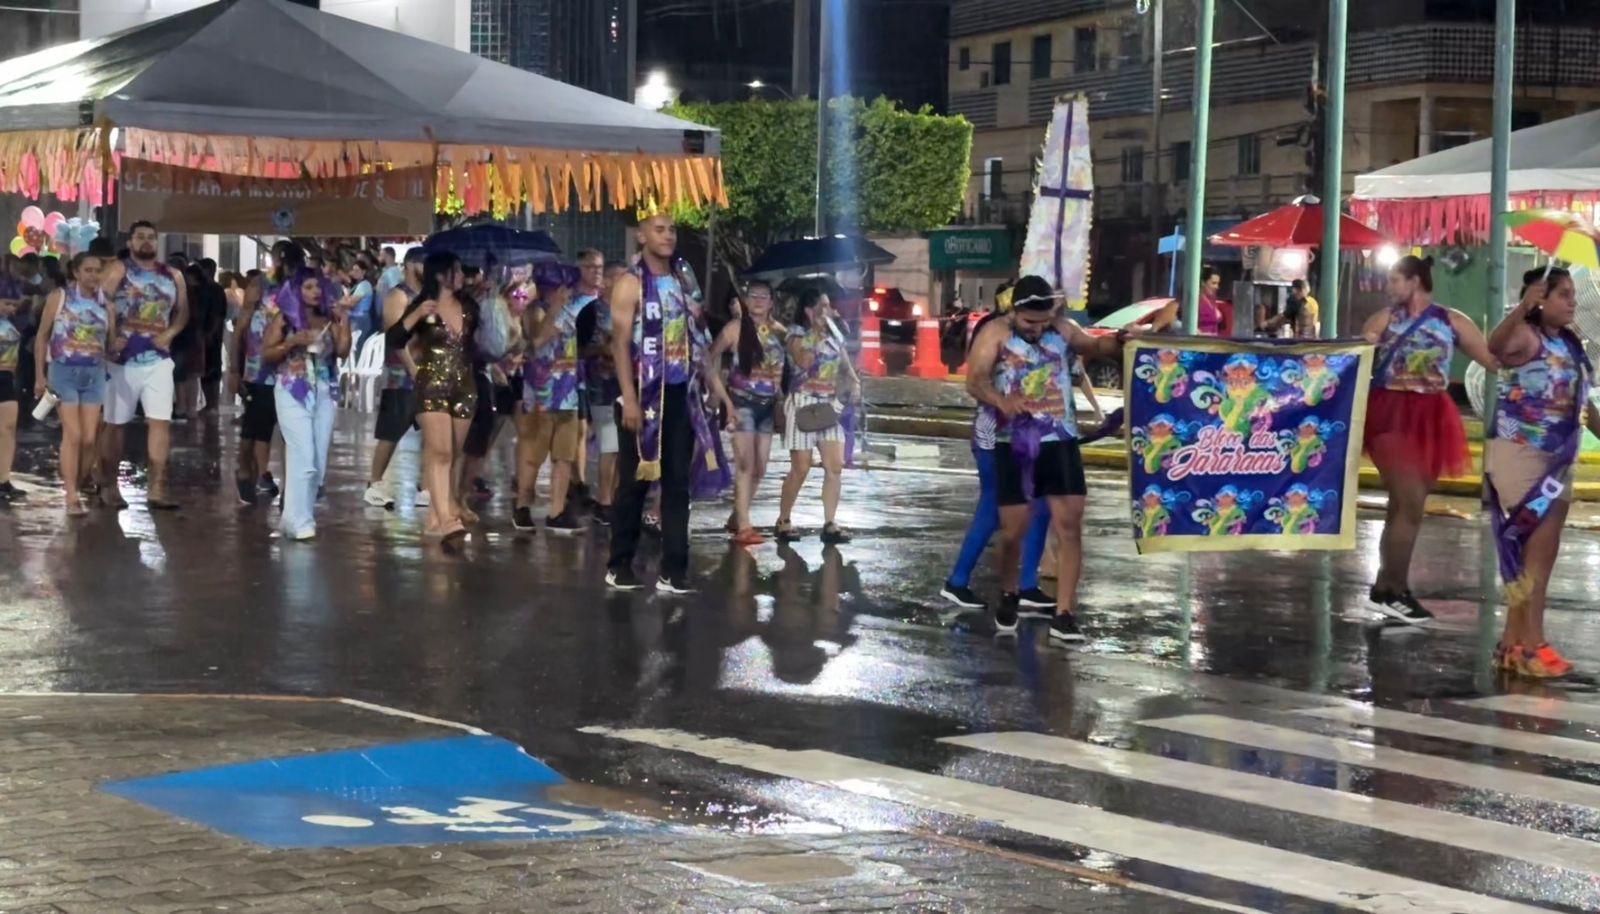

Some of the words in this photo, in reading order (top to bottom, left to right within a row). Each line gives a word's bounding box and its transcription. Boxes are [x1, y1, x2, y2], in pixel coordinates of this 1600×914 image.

[642, 301, 662, 379] REI
[1197, 425, 1244, 450] Bloco
[1249, 425, 1278, 449] das
[1167, 447, 1288, 482] Jararacas
